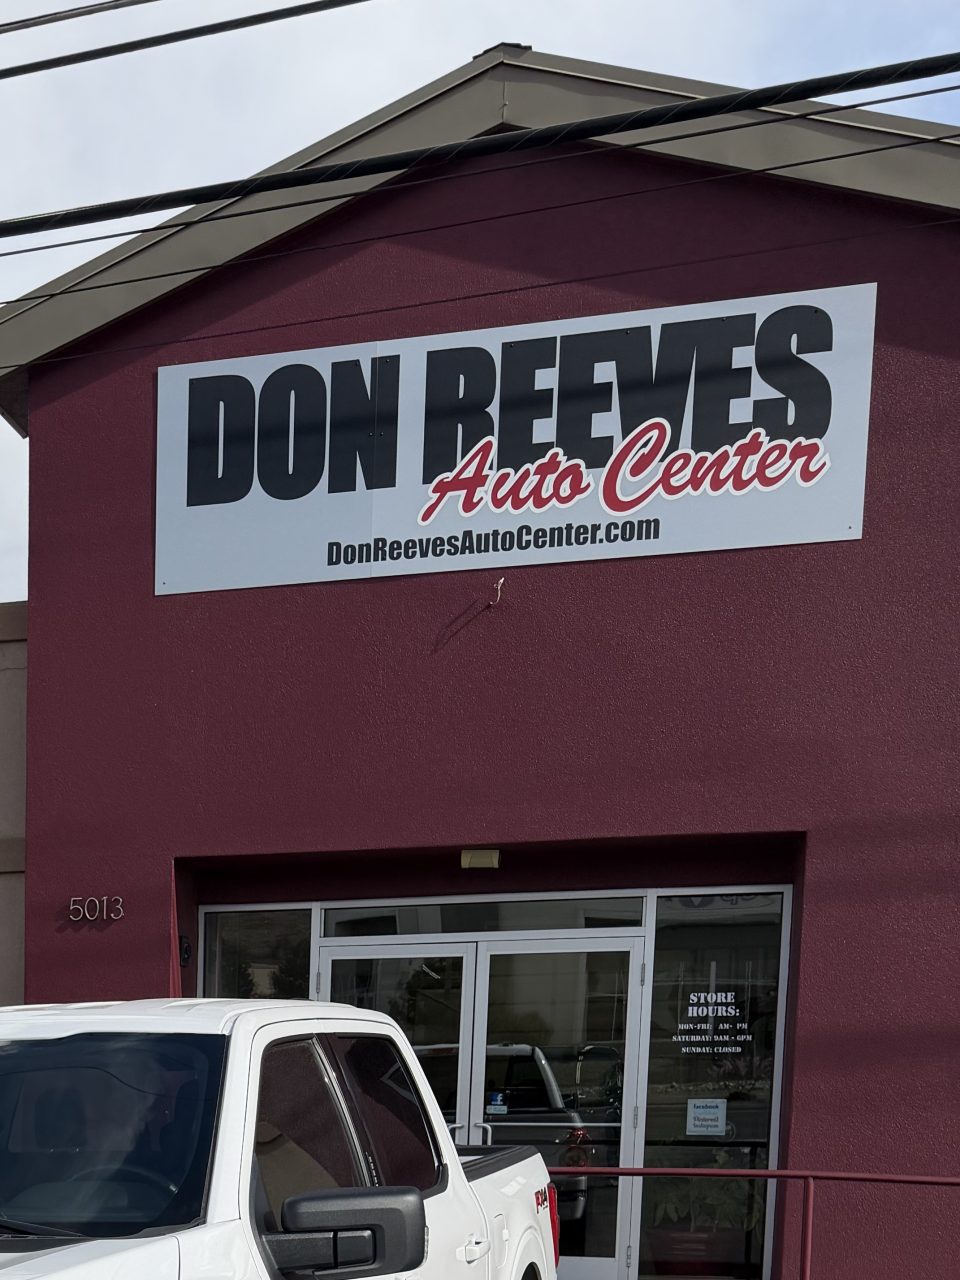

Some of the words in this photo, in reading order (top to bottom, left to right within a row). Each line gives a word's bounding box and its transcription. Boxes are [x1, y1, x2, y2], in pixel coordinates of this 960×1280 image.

[187, 354, 400, 507] DON
[422, 304, 834, 485] REEVES
[419, 438, 588, 524] Auto
[600, 418, 829, 513] Center
[327, 515, 661, 566] DonReevesAutoCenter.com
[69, 896, 124, 921] 5013
[687, 1005, 740, 1017] HOURS:
[689, 992, 735, 1004] STORE
